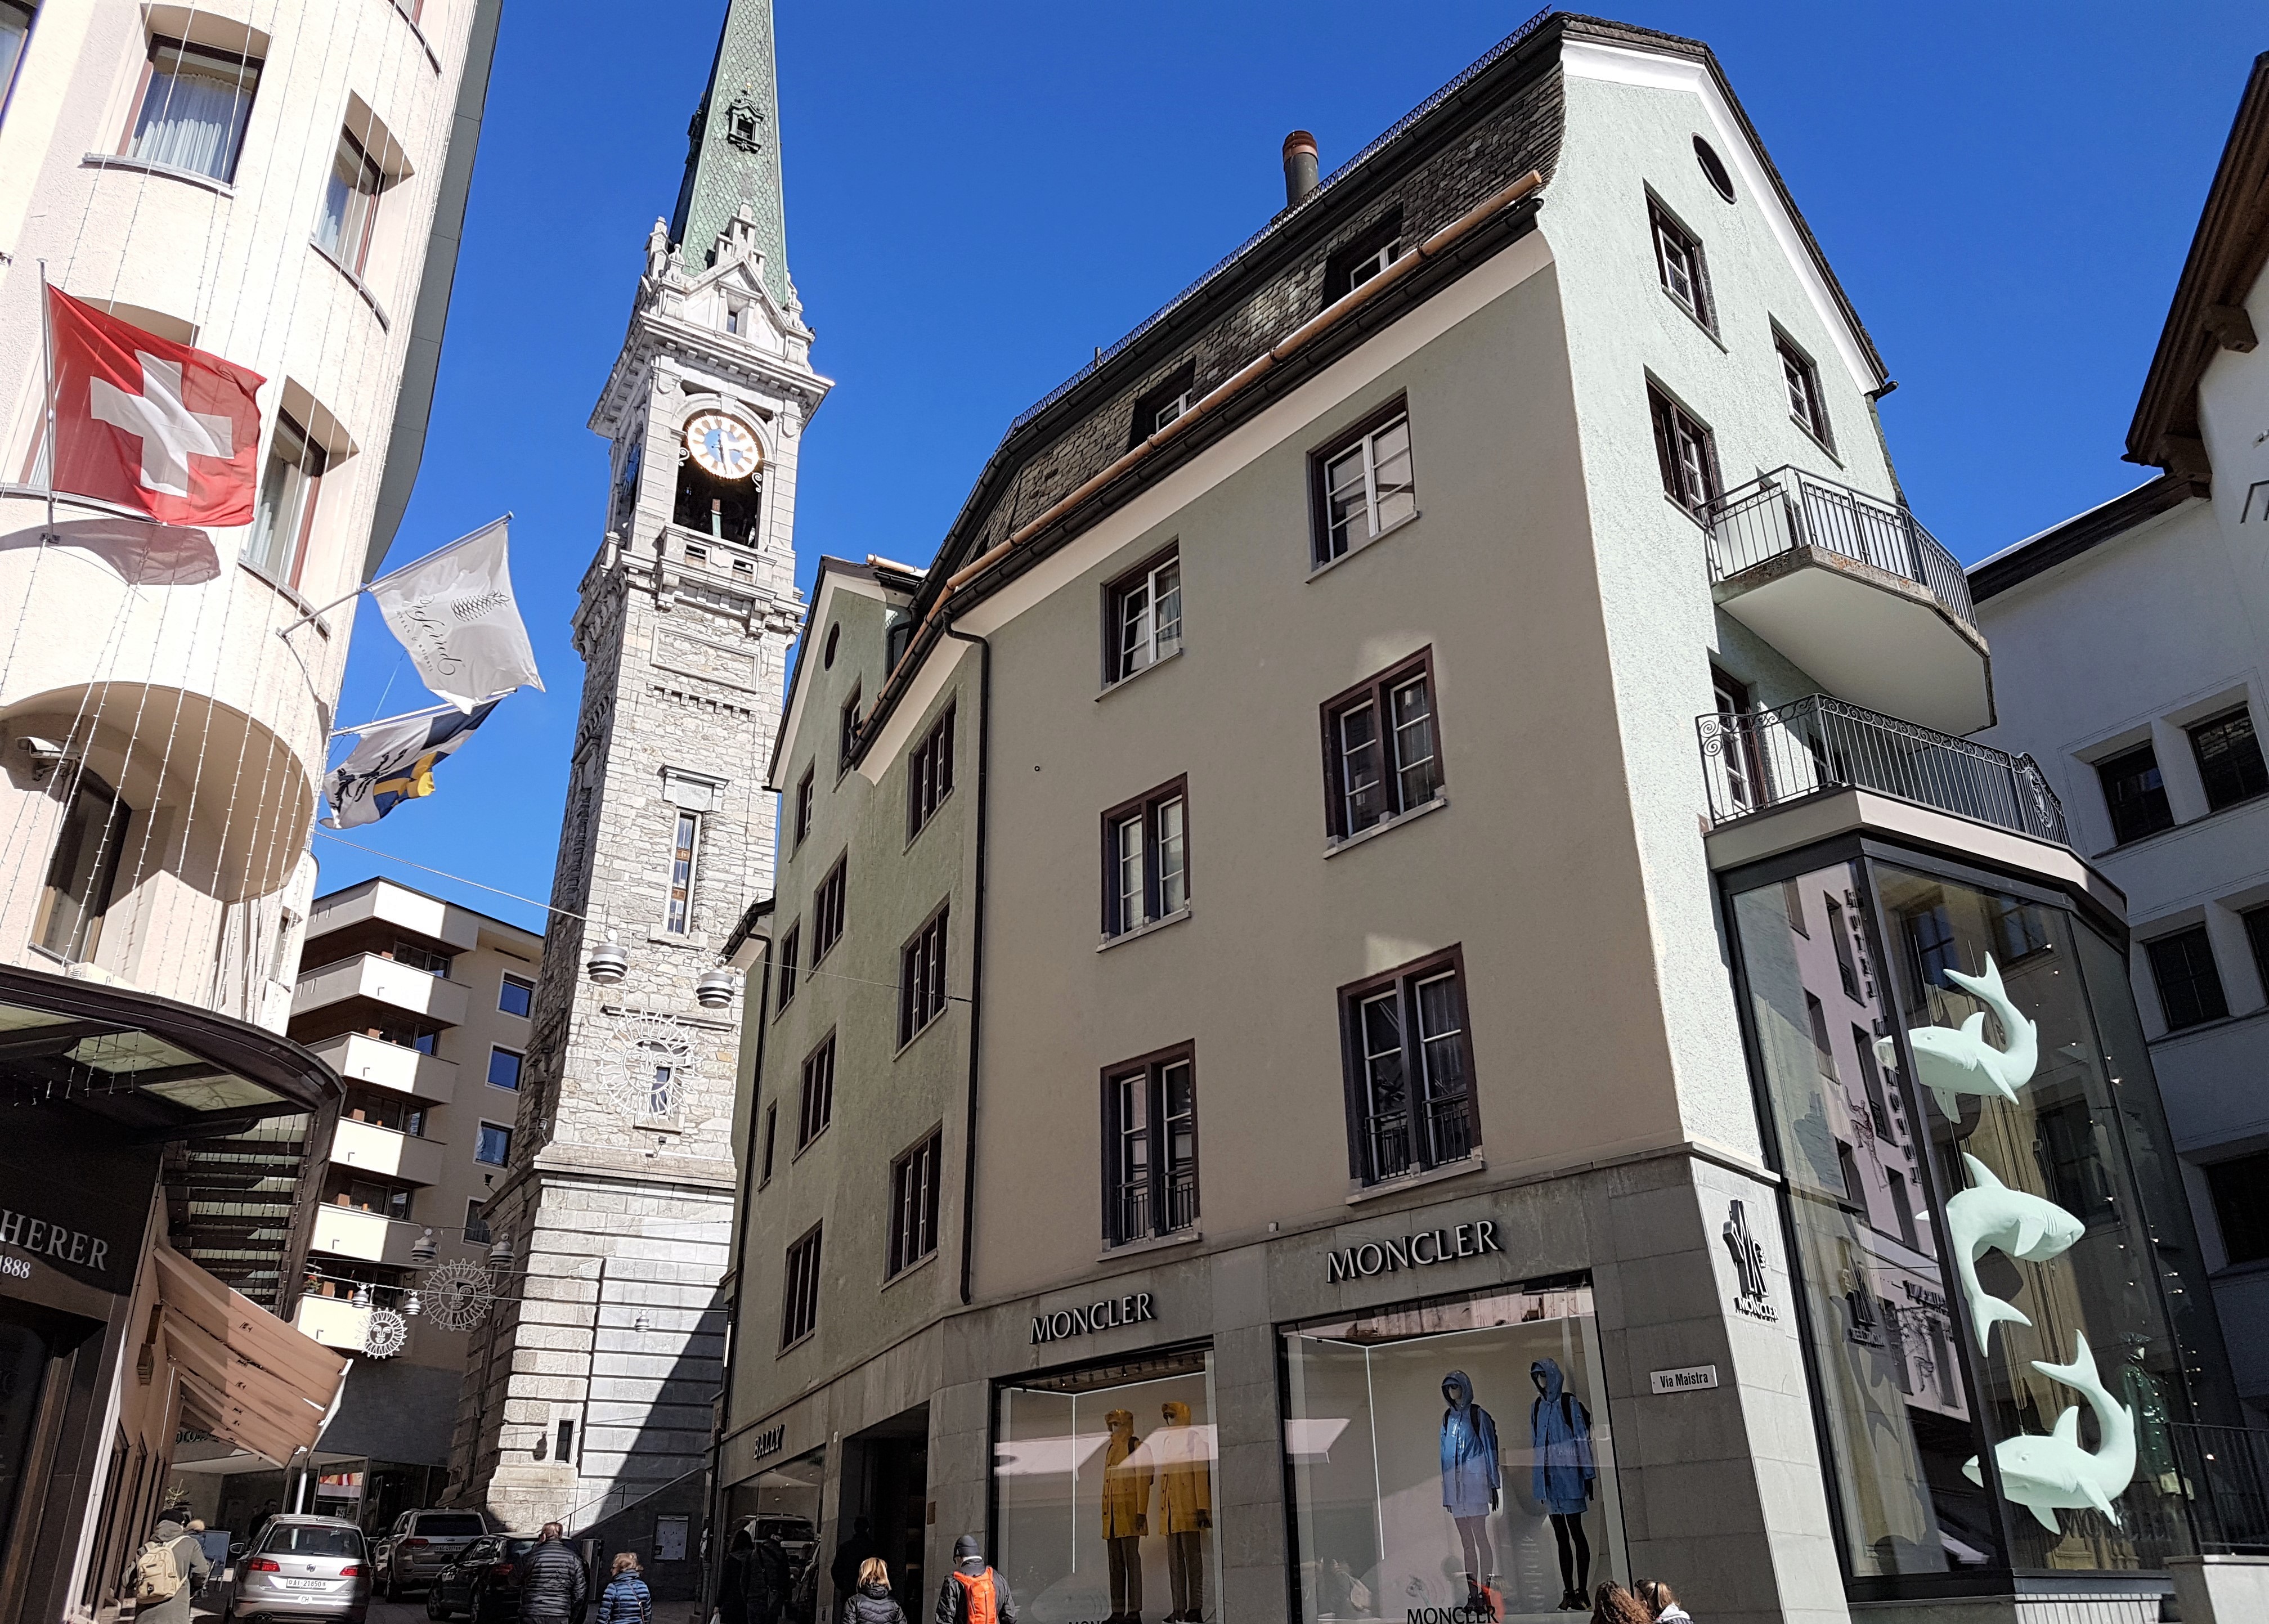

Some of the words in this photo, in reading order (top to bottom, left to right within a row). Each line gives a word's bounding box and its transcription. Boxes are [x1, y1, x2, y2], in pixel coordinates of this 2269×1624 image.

[0, 1209, 108, 1271] HERER
[1326, 1220, 1501, 1284] MONCLER
[1029, 1292, 1155, 1345] MONCLER
[1737, 1296, 1780, 1321] MONCLER
[1660, 1375, 1674, 1388] Via
[1675, 1372, 1709, 1387] Maistra
[753, 1424, 784, 1460] BALLY
